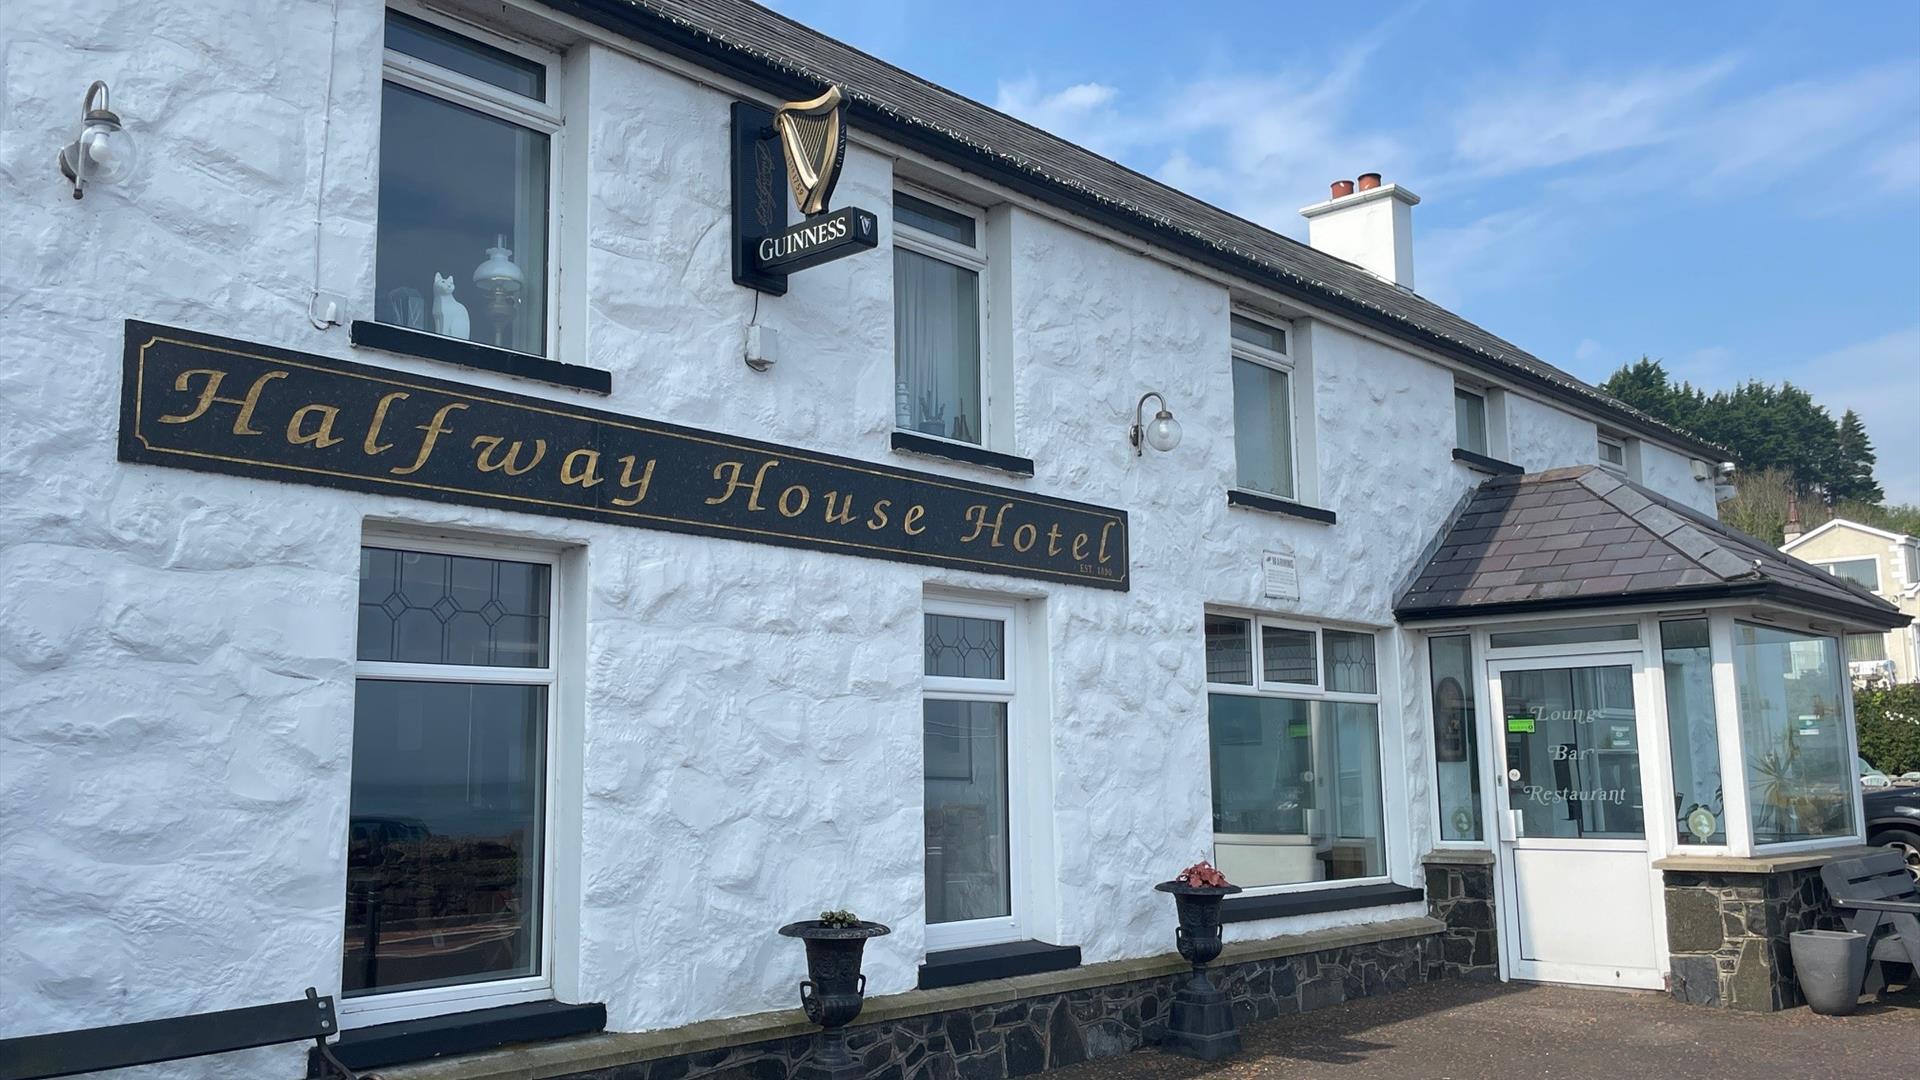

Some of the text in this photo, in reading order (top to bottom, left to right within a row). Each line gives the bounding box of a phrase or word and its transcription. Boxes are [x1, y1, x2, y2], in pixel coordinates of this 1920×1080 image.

[759, 216, 847, 261] GUINNESS
[158, 368, 1116, 563] Halfway House Hotel
[1529, 705, 1607, 724] Lounge
[1547, 744, 1595, 761] Bar
[1523, 785, 1626, 805] Restaurant
